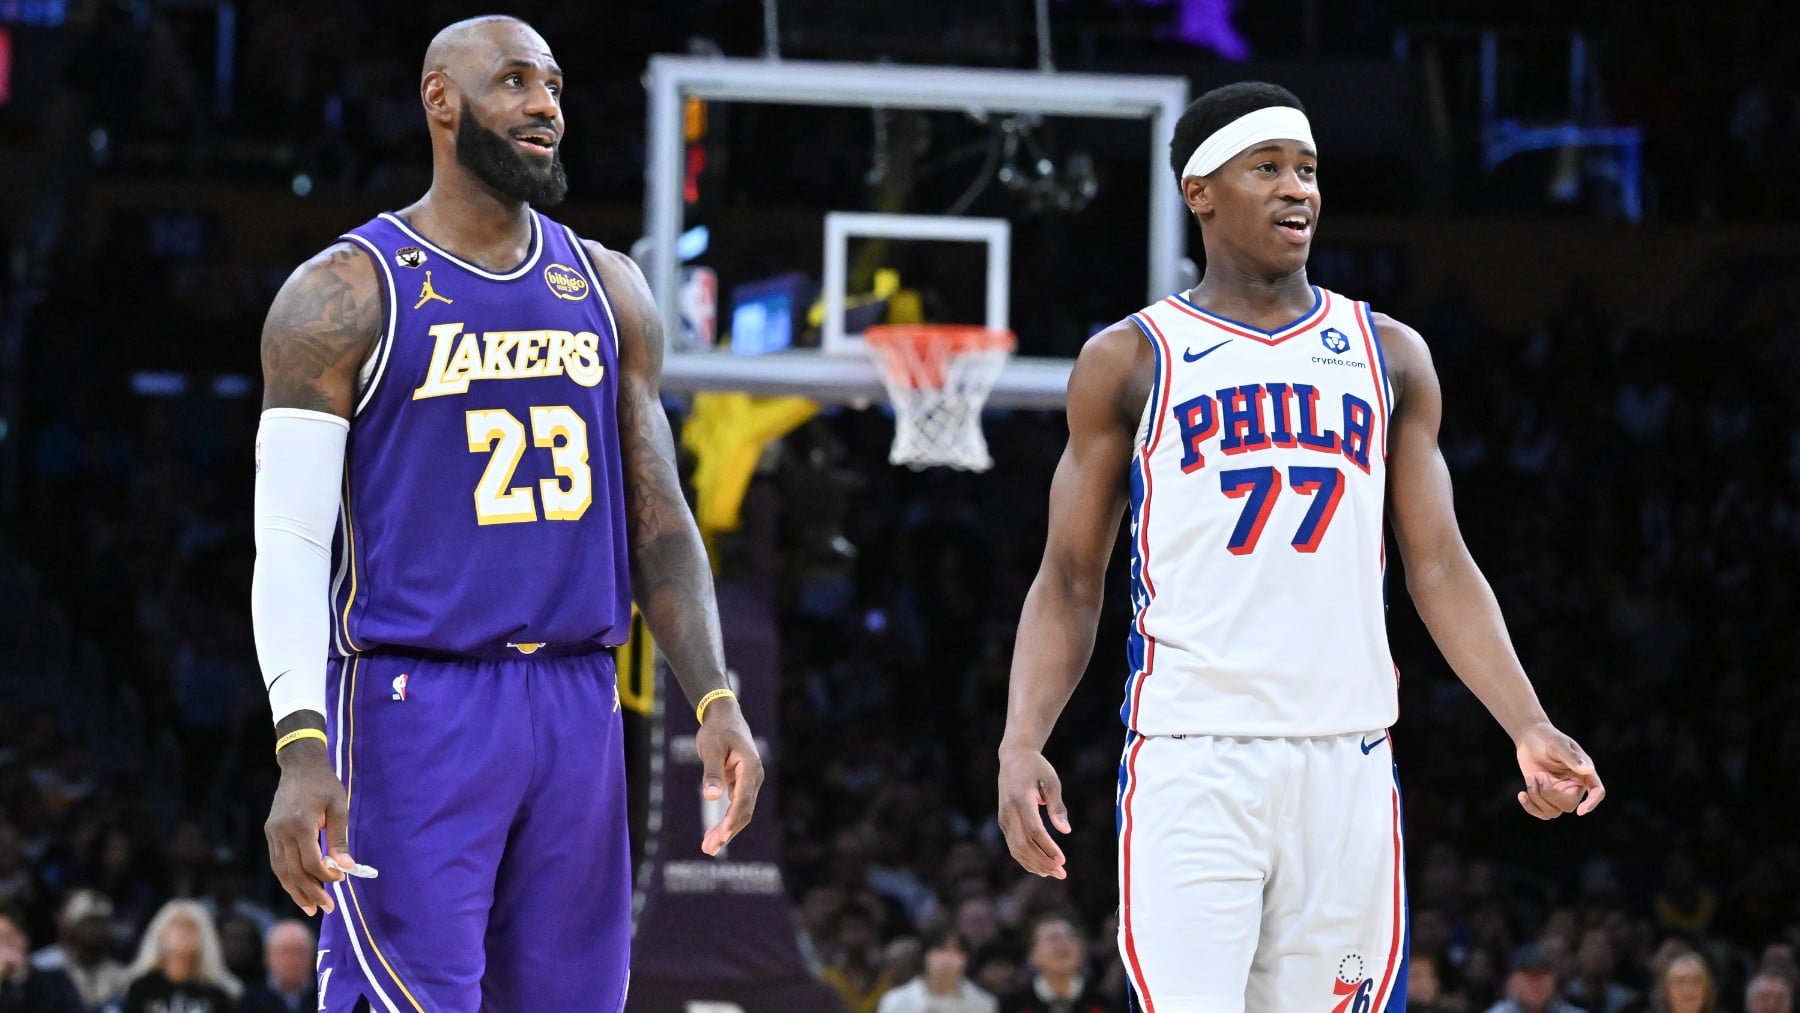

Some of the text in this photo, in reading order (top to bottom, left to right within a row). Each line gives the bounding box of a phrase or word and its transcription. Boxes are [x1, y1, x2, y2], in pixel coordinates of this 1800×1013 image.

[547, 271, 585, 292] bibigo
[413, 322, 604, 401] LAKERS
[1311, 356, 1366, 369] crypto.com
[465, 405, 592, 526] 23
[1173, 382, 1375, 475] PHILA
[1219, 466, 1345, 556] 77
